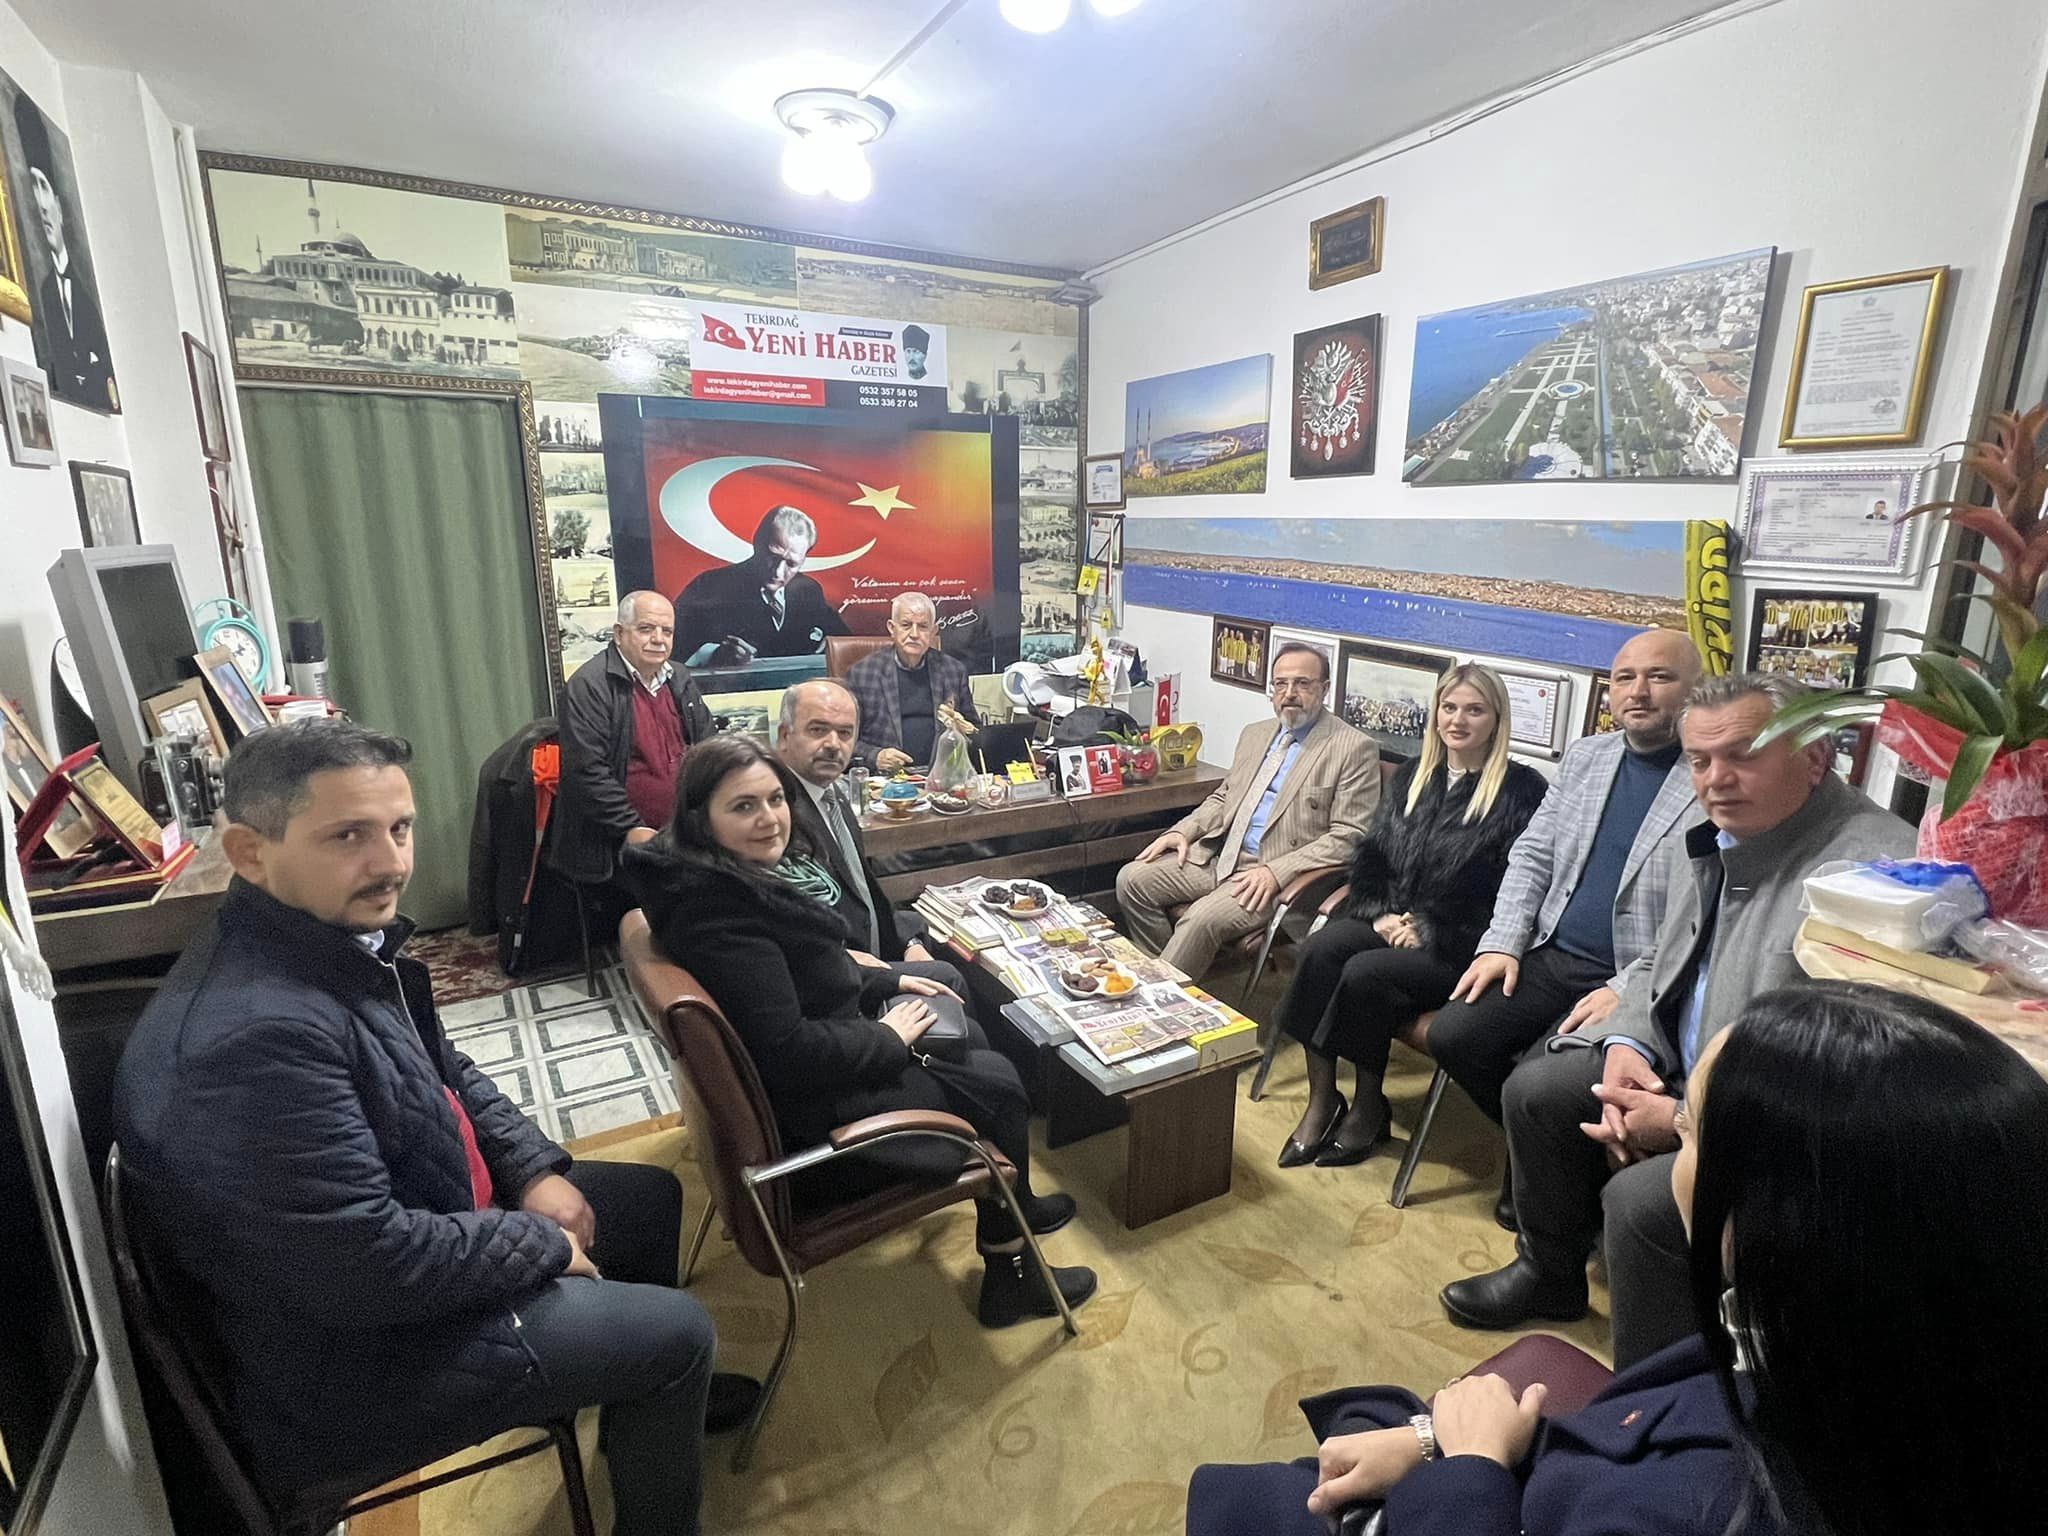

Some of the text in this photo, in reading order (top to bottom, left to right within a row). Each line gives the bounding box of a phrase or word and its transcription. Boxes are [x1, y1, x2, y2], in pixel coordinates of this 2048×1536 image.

[744, 312, 799, 328] TEKİRDAĞ
[745, 326, 897, 364] YENİ HABER
[859, 385, 879, 395] 0532
[881, 387, 895, 396] 357
[908, 389, 918, 397] 05
[859, 397, 880, 406] 0533
[897, 399, 907, 408] 27
[908, 400, 918, 408] 04
